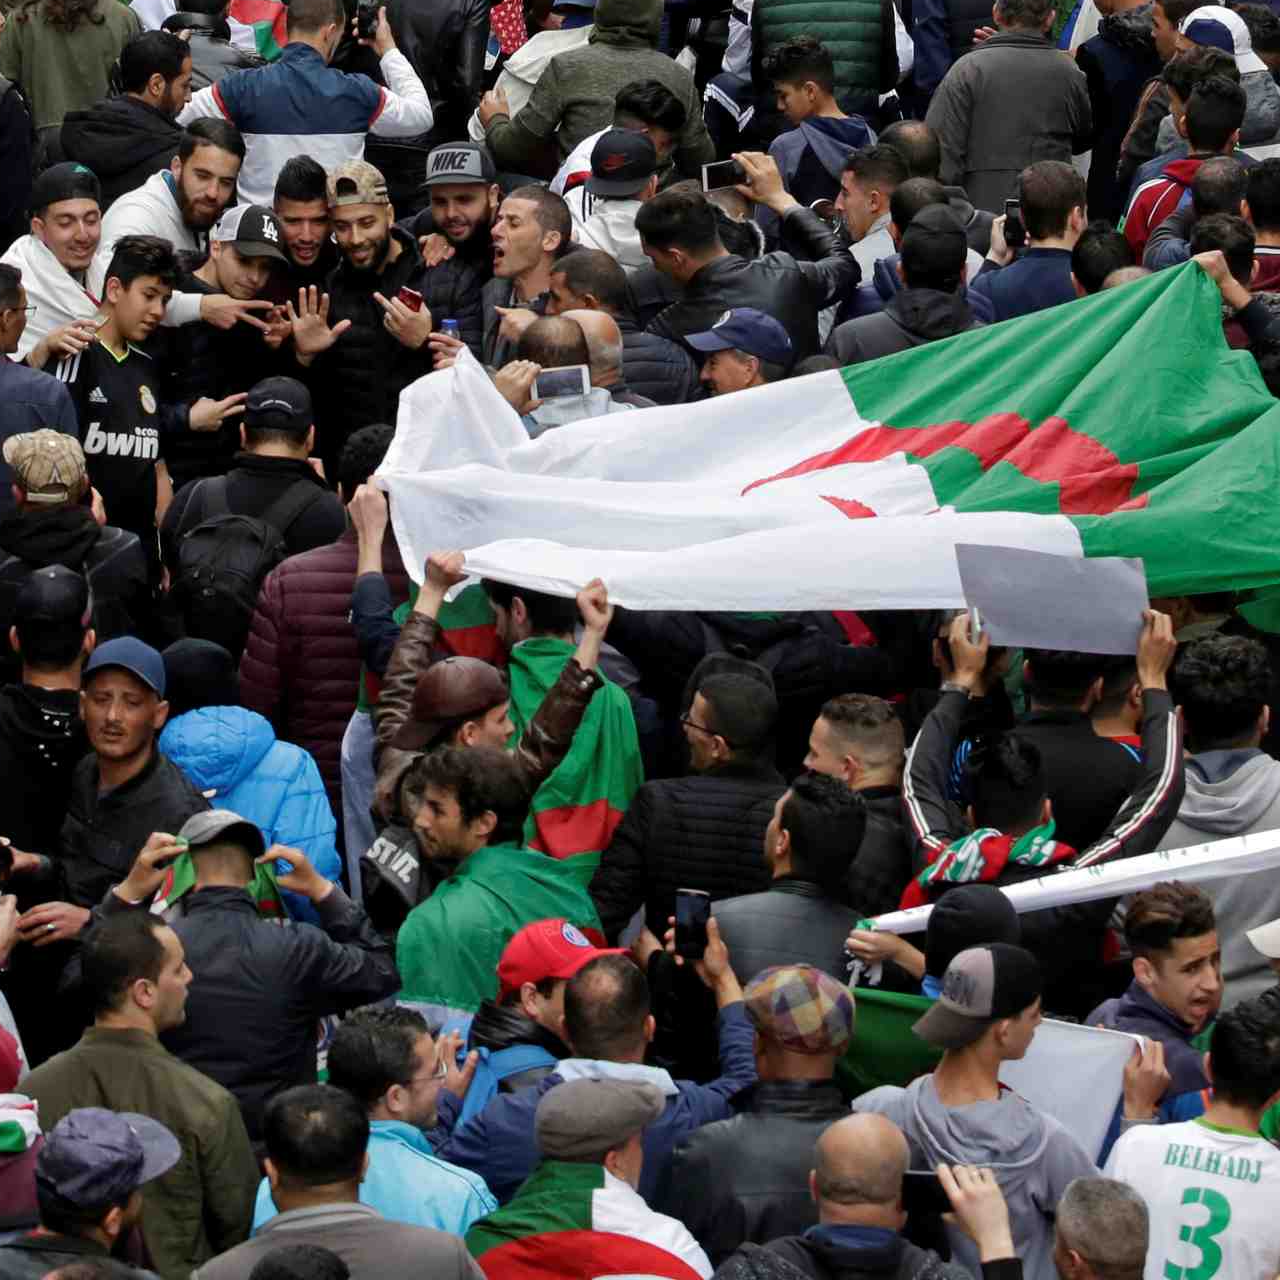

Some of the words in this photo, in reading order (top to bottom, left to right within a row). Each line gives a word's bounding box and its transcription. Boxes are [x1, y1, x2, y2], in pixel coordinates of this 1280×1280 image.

[432, 151, 471, 171] NIKE
[262, 215, 278, 242] LA
[83, 422, 159, 459] bwin
[1164, 1142, 1263, 1183] BELHADJ
[1162, 1186, 1232, 1280] 3
